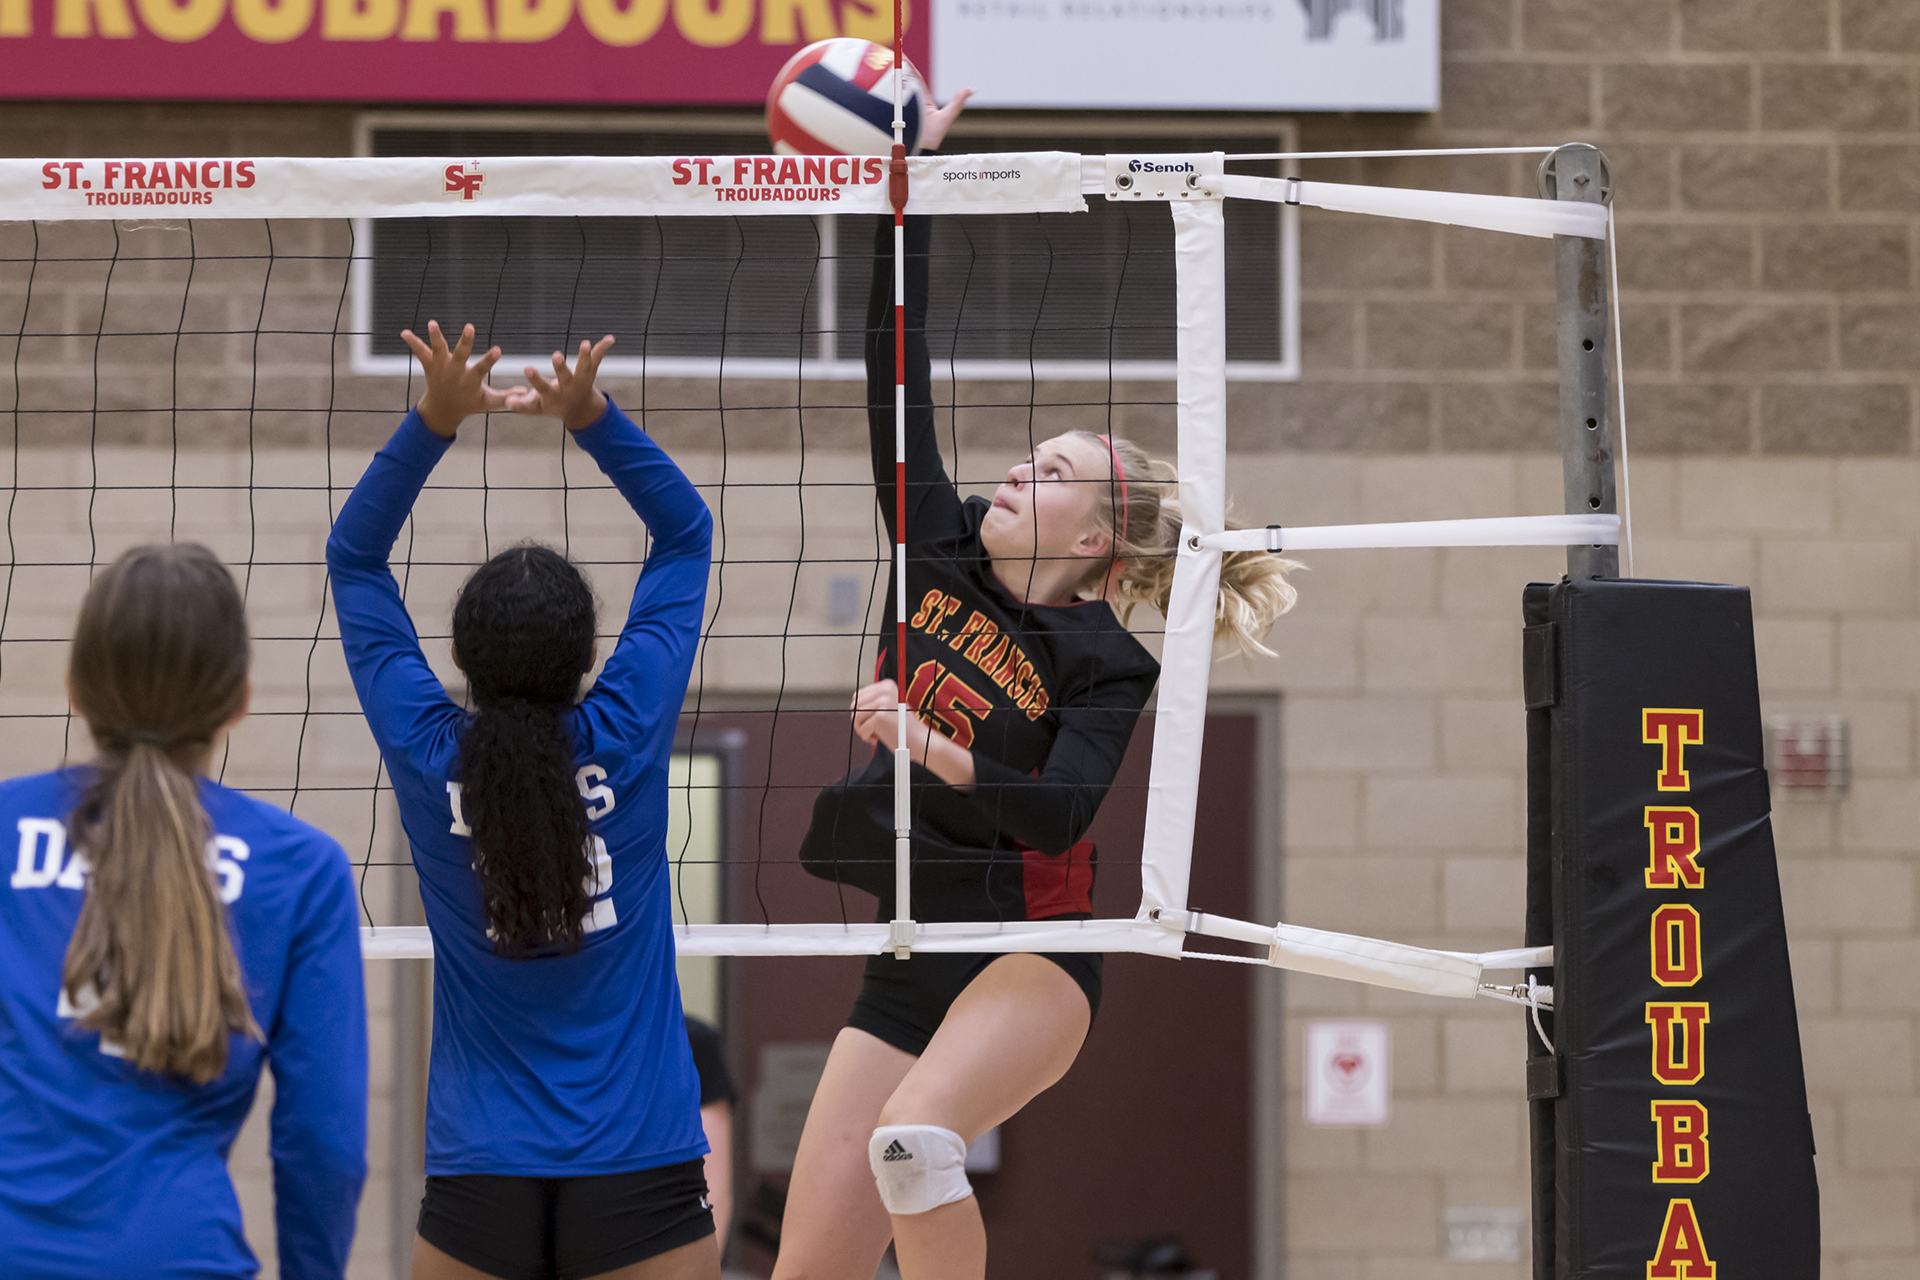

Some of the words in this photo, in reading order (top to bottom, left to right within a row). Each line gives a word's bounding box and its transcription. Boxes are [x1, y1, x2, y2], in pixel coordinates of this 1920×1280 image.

[41, 161, 92, 189] ST.
[104, 161, 256, 189] FRANCIS
[672, 158, 722, 185] ST.
[733, 157, 883, 185] FRANCIS
[943, 171, 978, 182] sports
[1143, 162, 1195, 173] Senoh
[85, 191, 213, 206] TROUBADOURS
[715, 187, 841, 202] TROUBADOURS
[911, 588, 962, 641] ST.
[949, 610, 1049, 721] FRANCIS
[906, 659, 994, 749] 15
